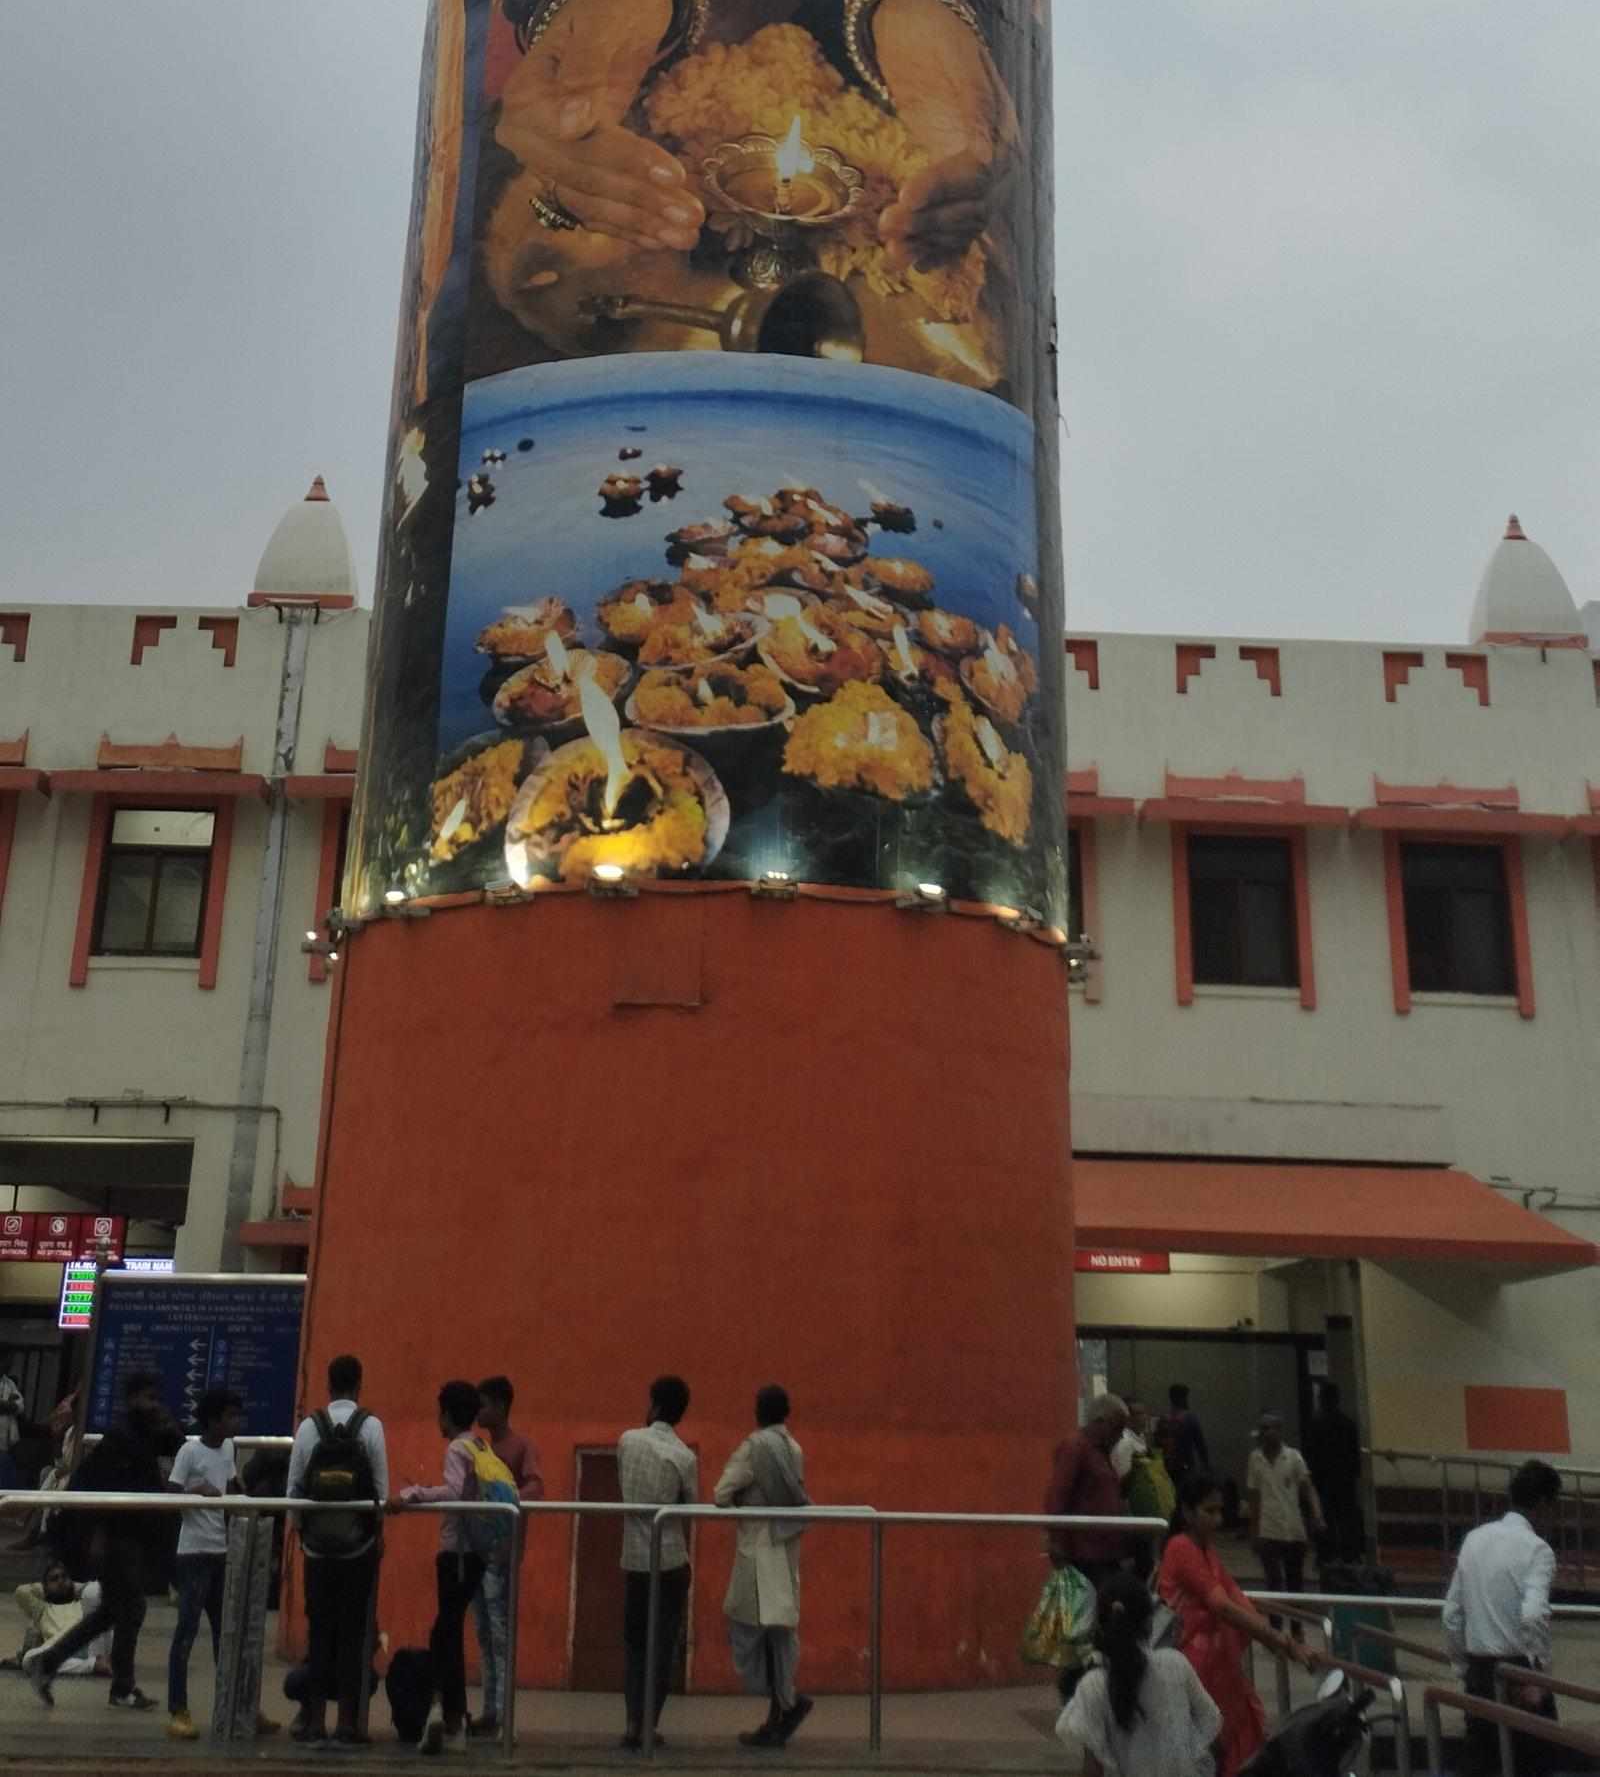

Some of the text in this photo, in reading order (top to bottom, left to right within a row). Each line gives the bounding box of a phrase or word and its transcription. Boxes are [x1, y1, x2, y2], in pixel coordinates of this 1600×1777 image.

[125, 1261, 151, 1271] TRAIN
[1090, 1254, 1142, 1268] NO ENTRY
